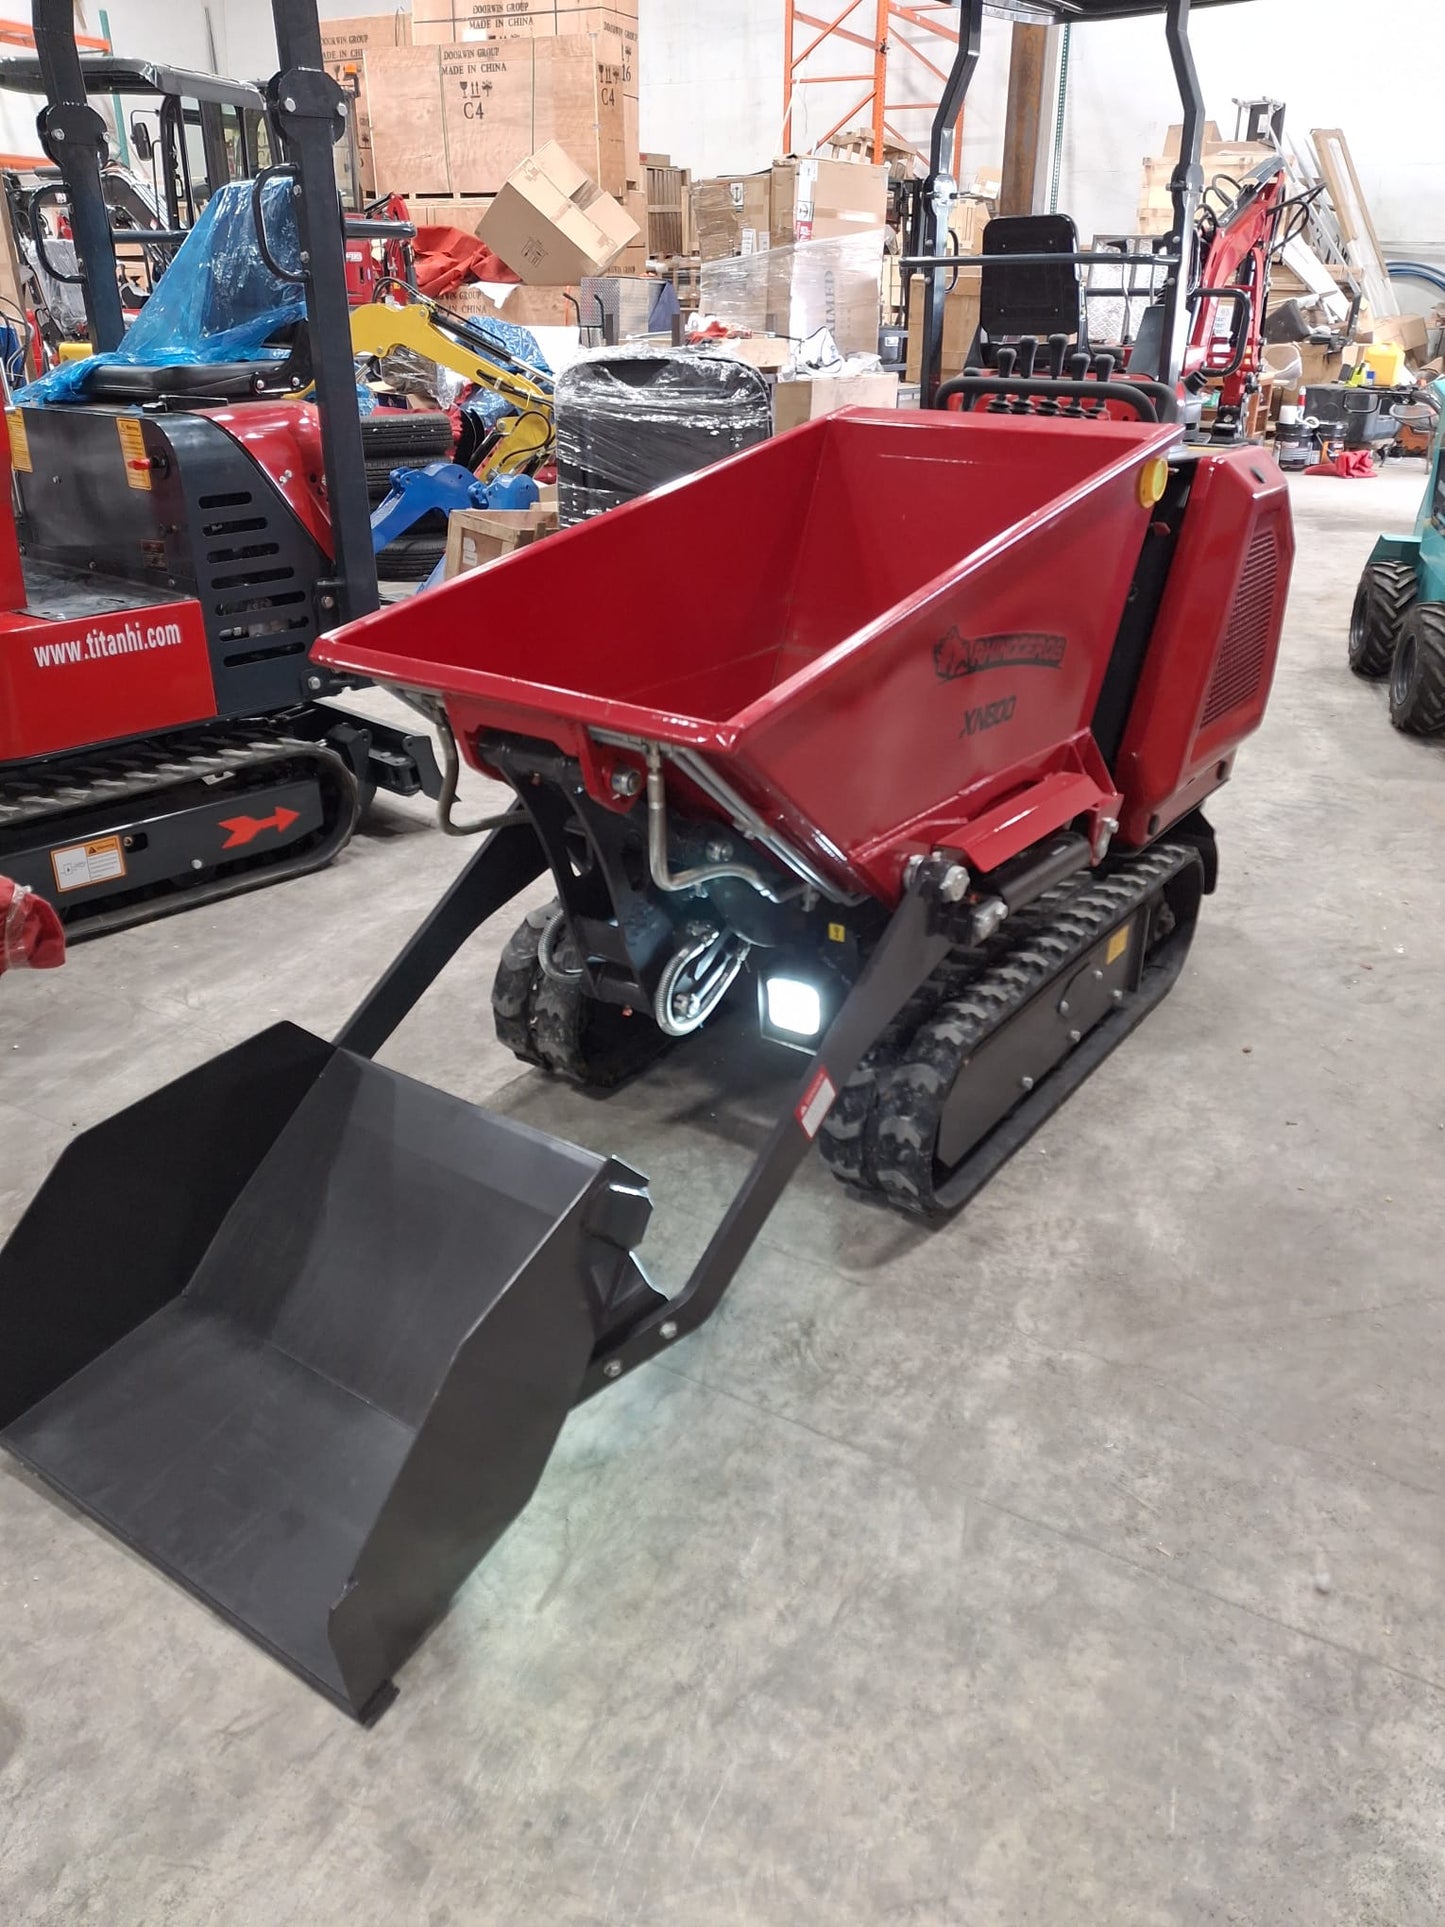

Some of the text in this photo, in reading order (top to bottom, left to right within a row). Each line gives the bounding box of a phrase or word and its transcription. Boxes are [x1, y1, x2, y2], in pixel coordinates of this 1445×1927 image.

[473, 2, 529, 15] DOORWIN GROUP
[469, 16, 534, 29] MADE IN CHINA
[348, 33, 369, 44] GROUP
[323, 50, 336, 60] ADE
[339, 49, 347, 58] IN
[443, 47, 500, 60] DOORWIN GROUP
[442, 62, 507, 76] MADE IN CHINA
[601, 87, 615, 106] C4
[463, 101, 485, 120] C4
[459, 290, 482, 300] GROUP
[449, 304, 458, 312] IN
[461, 303, 488, 314] CHINA
[33, 622, 181, 667] www.titanhi.com
